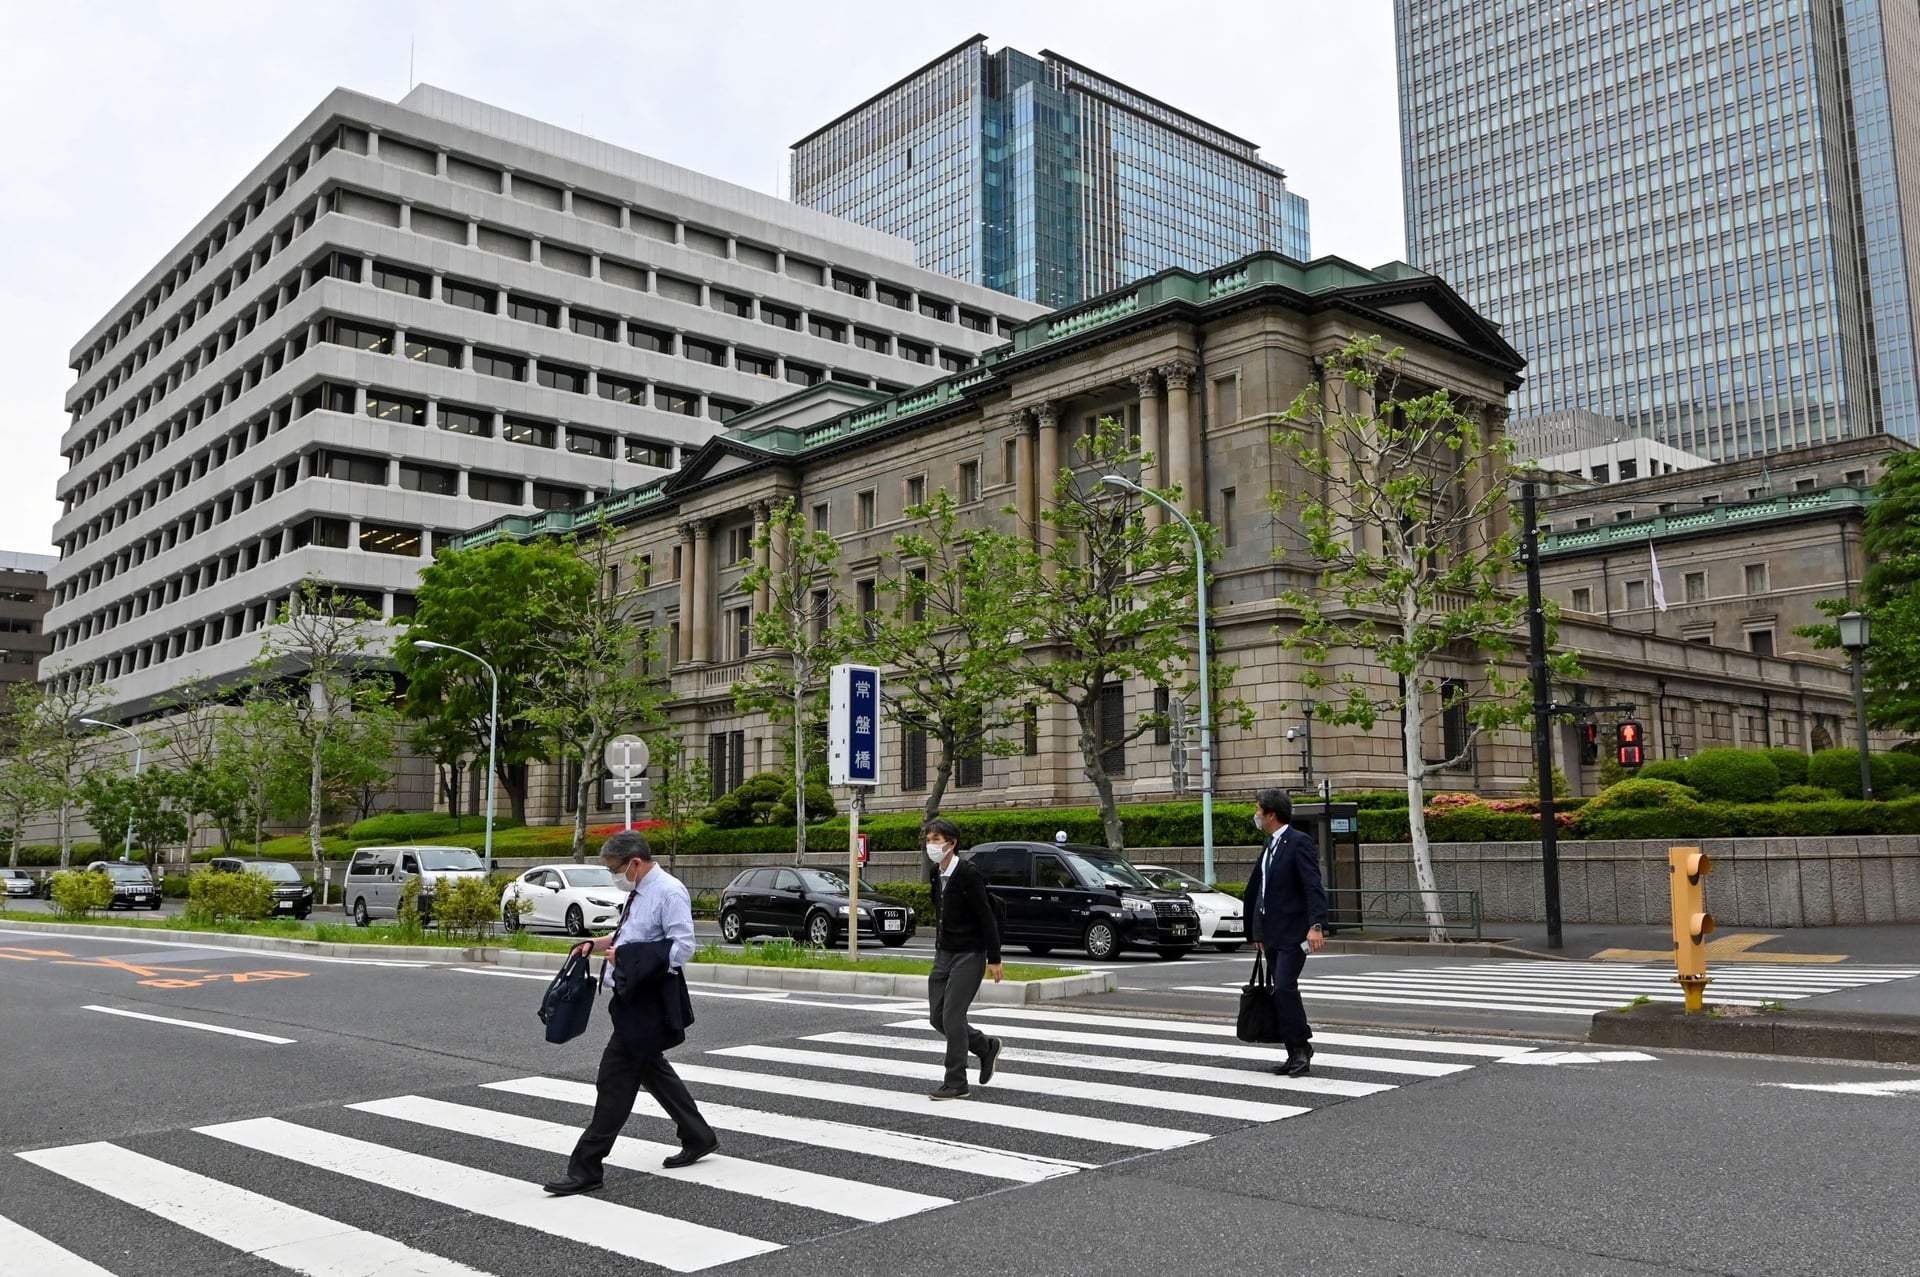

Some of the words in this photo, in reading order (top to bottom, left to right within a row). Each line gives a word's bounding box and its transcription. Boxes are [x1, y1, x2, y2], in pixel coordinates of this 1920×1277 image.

[855, 680, 870, 769] 常盤橋
[136, 970, 311, 988] 8-20
